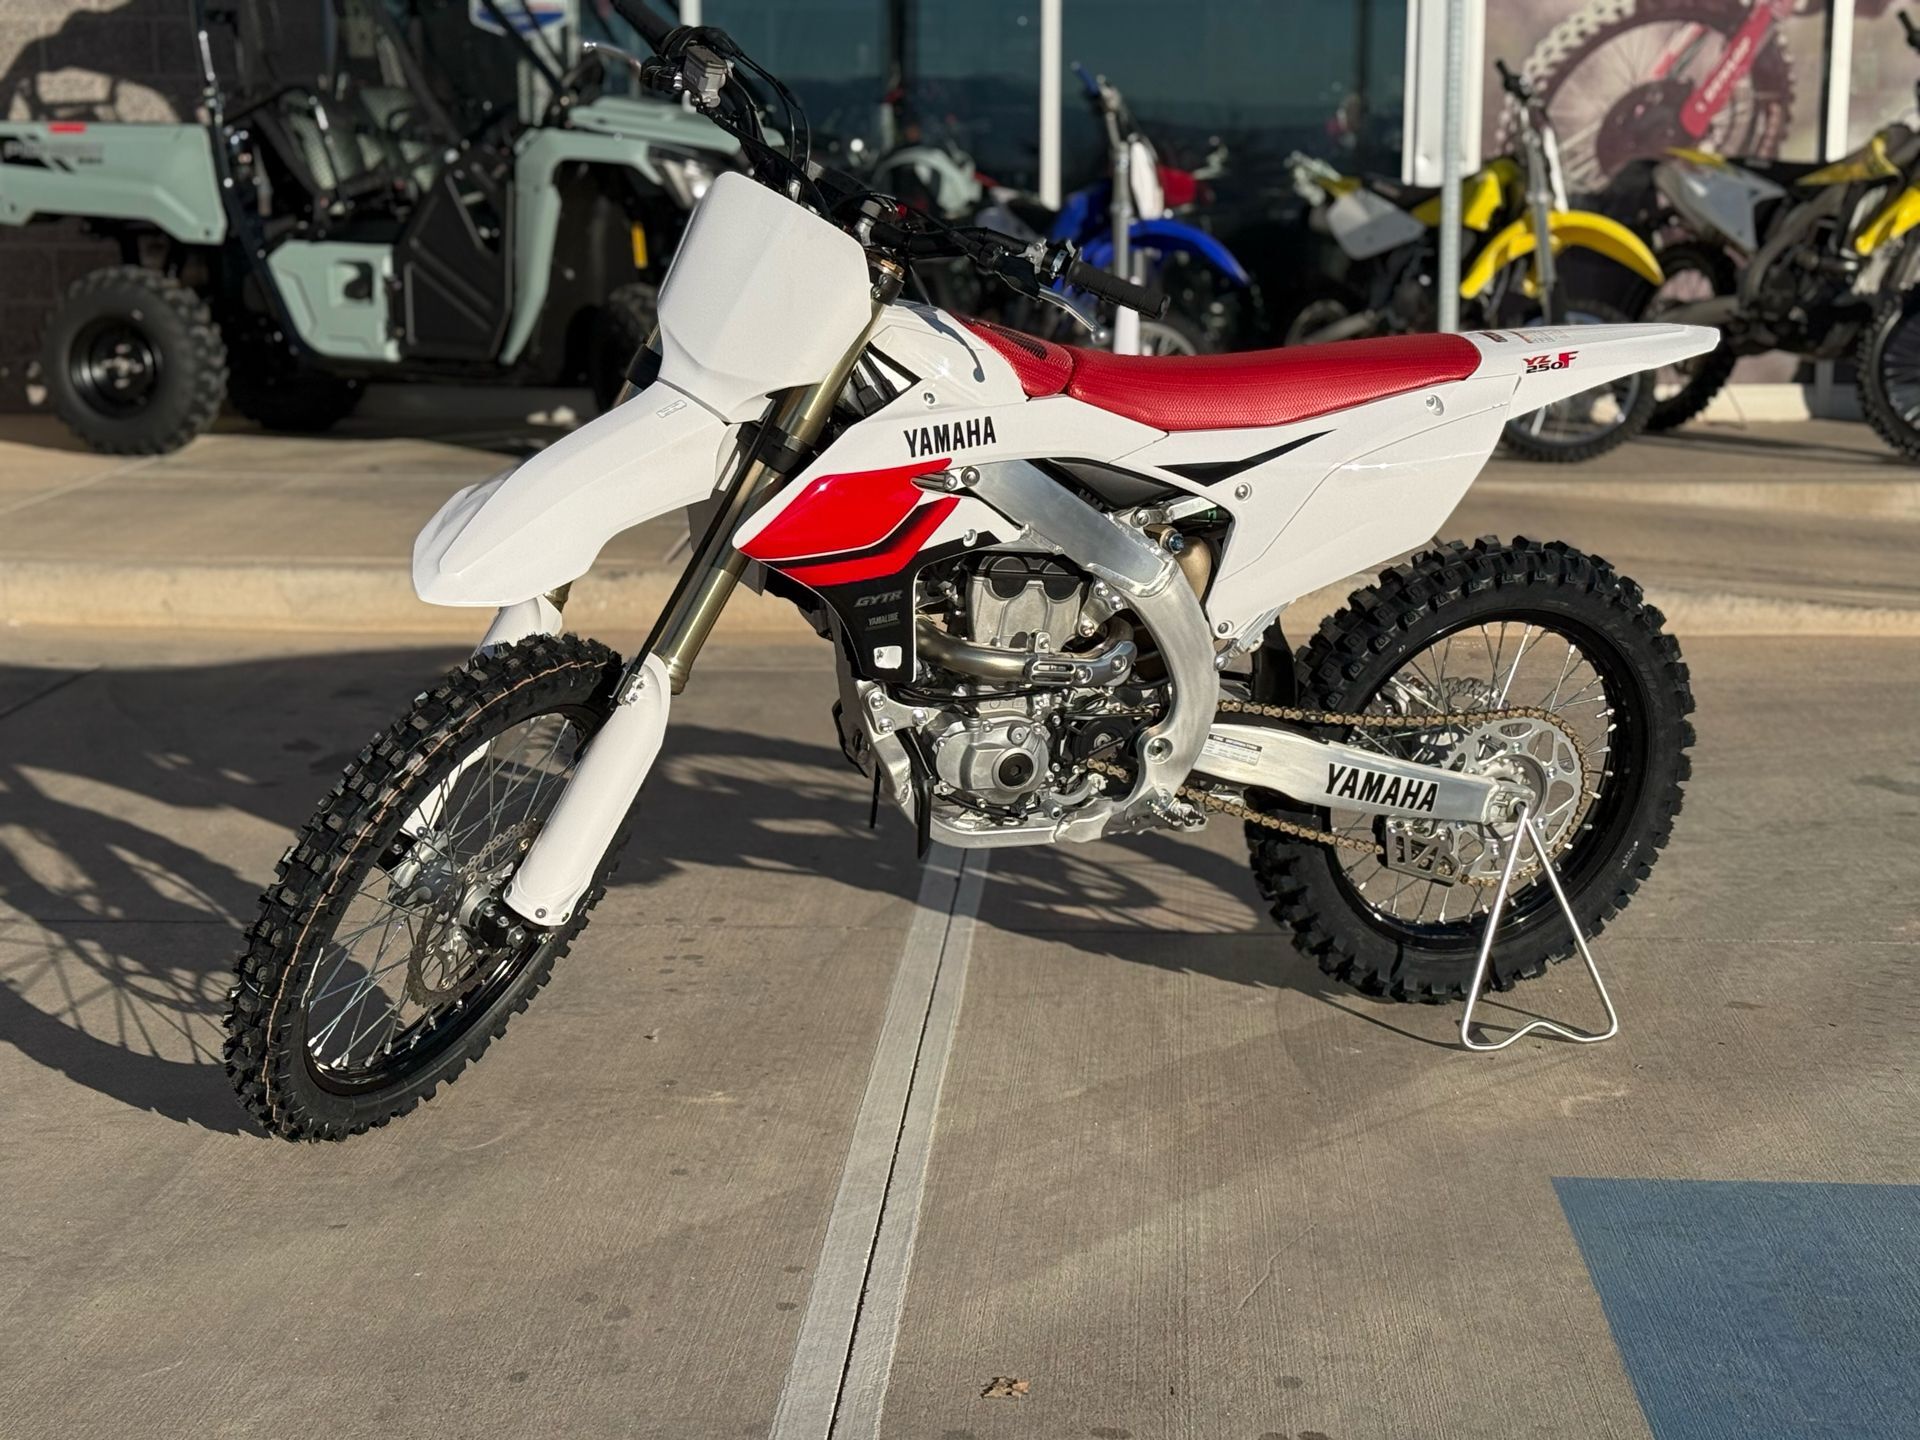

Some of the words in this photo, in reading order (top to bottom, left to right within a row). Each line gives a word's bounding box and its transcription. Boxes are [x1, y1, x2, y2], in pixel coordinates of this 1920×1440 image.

[1522, 354, 1552, 366] YZ
[903, 416, 997, 457] YAMAHA
[854, 590, 903, 607] GYTR
[1325, 763, 1439, 812] YAMAHA
